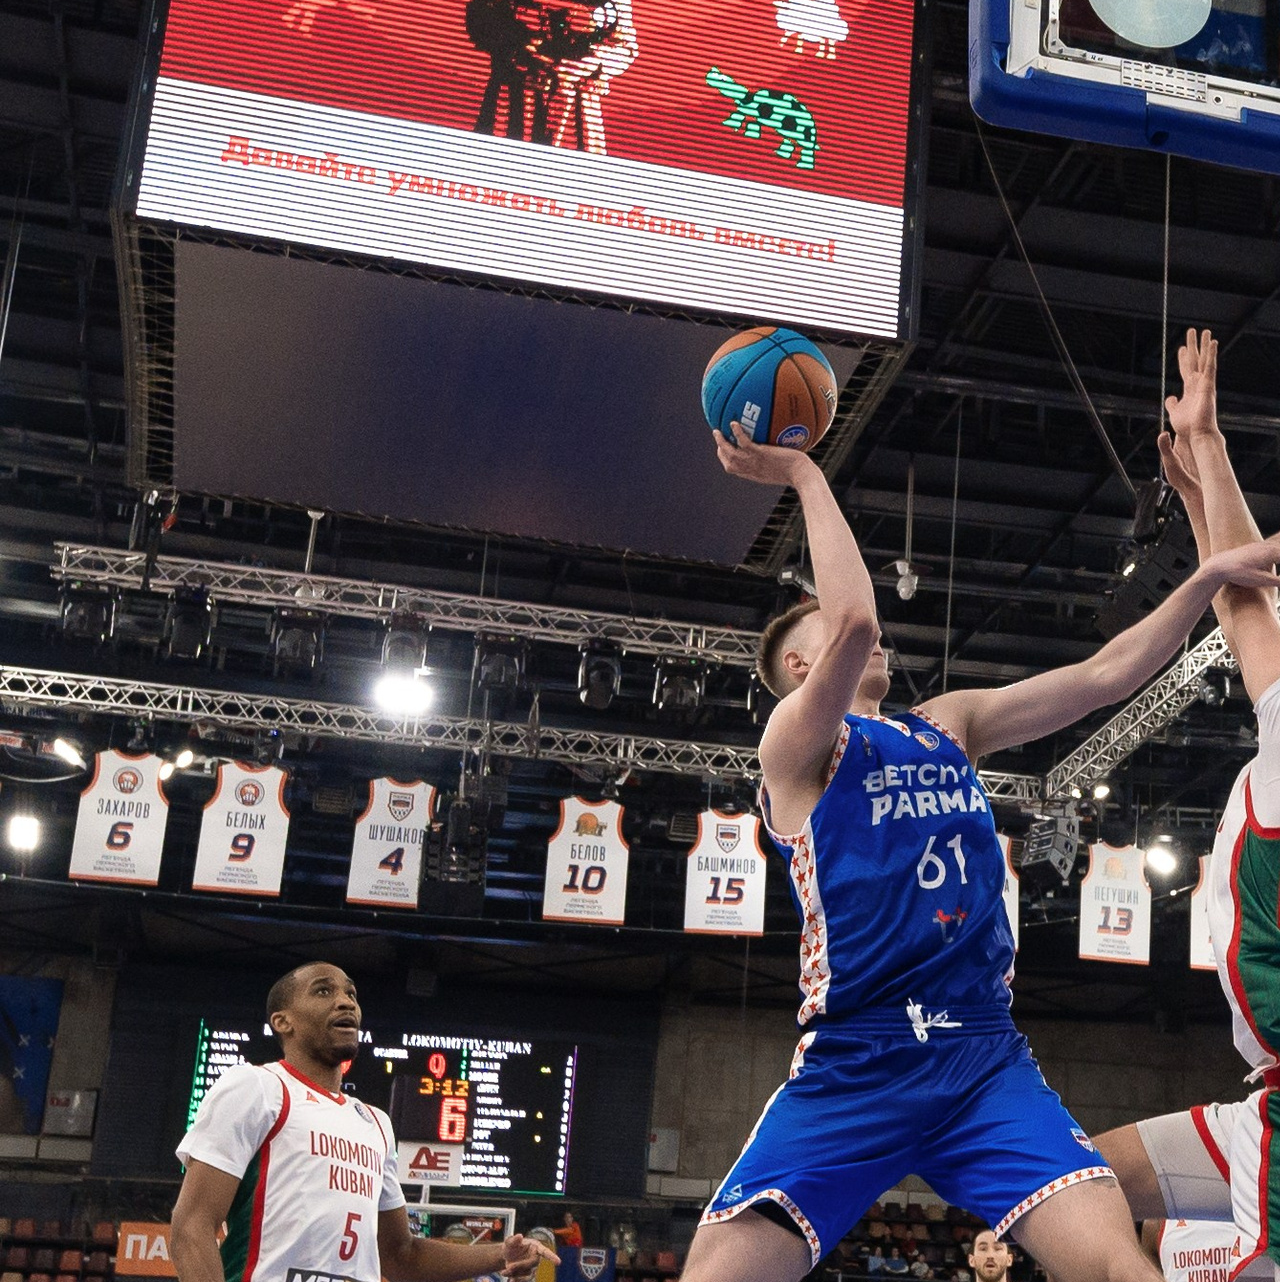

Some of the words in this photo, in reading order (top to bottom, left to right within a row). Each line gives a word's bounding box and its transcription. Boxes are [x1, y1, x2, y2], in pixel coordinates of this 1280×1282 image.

[221, 136, 376, 185] Давайте
[388, 171, 566, 216] умножать
[574, 205, 706, 241] любовь
[97, 798, 150, 819] ЗАХАРОВ
[226, 811, 267, 830] БЕЛЫХ
[870, 786, 988, 827] PARMA
[105, 821, 134, 852] 6
[228, 833, 256, 862] 9
[378, 847, 405, 876] 4
[570, 843, 606, 862] БЕЛОВ
[697, 855, 756, 875] БАШМИНОВ
[917, 834, 968, 890] 61
[562, 864, 608, 895] 10
[705, 876, 746, 906] 15
[1096, 905, 1134, 936] 13
[419, 1077, 469, 1097] 3:12
[438, 1096, 467, 1143] 6
[329, 1164, 374, 1200] KUBAN
[338, 1211, 362, 1261] 5
[1173, 1247, 1231, 1269] LOKOMOTI
